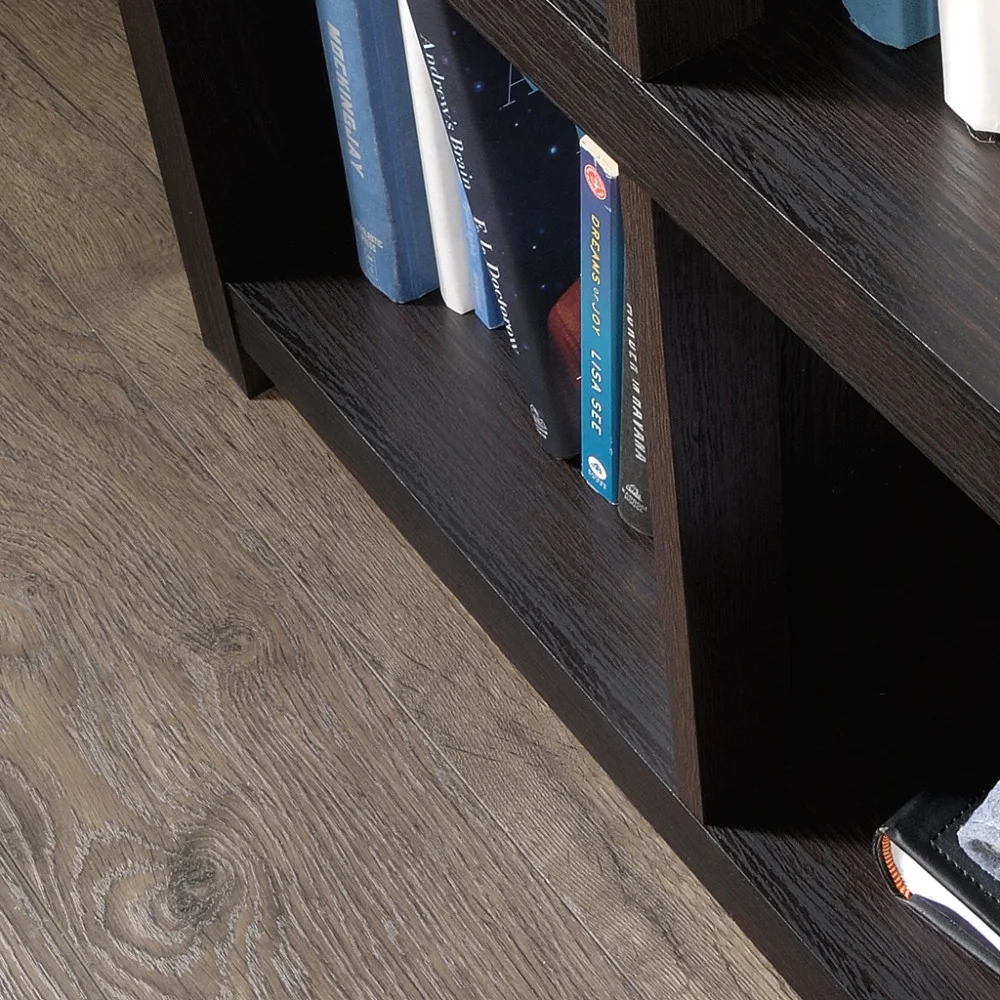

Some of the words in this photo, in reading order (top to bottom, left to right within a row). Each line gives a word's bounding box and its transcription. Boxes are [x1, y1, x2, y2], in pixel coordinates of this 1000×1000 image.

[326, 20, 365, 180] MOCKINGJAY
[419, 32, 456, 131] Andrew's
[449, 133, 472, 191] Brain
[591, 213, 602, 285] DREAMS
[591, 302, 602, 338] JOY
[591, 350, 602, 393] LISA
[591, 396, 602, 436] SEE
